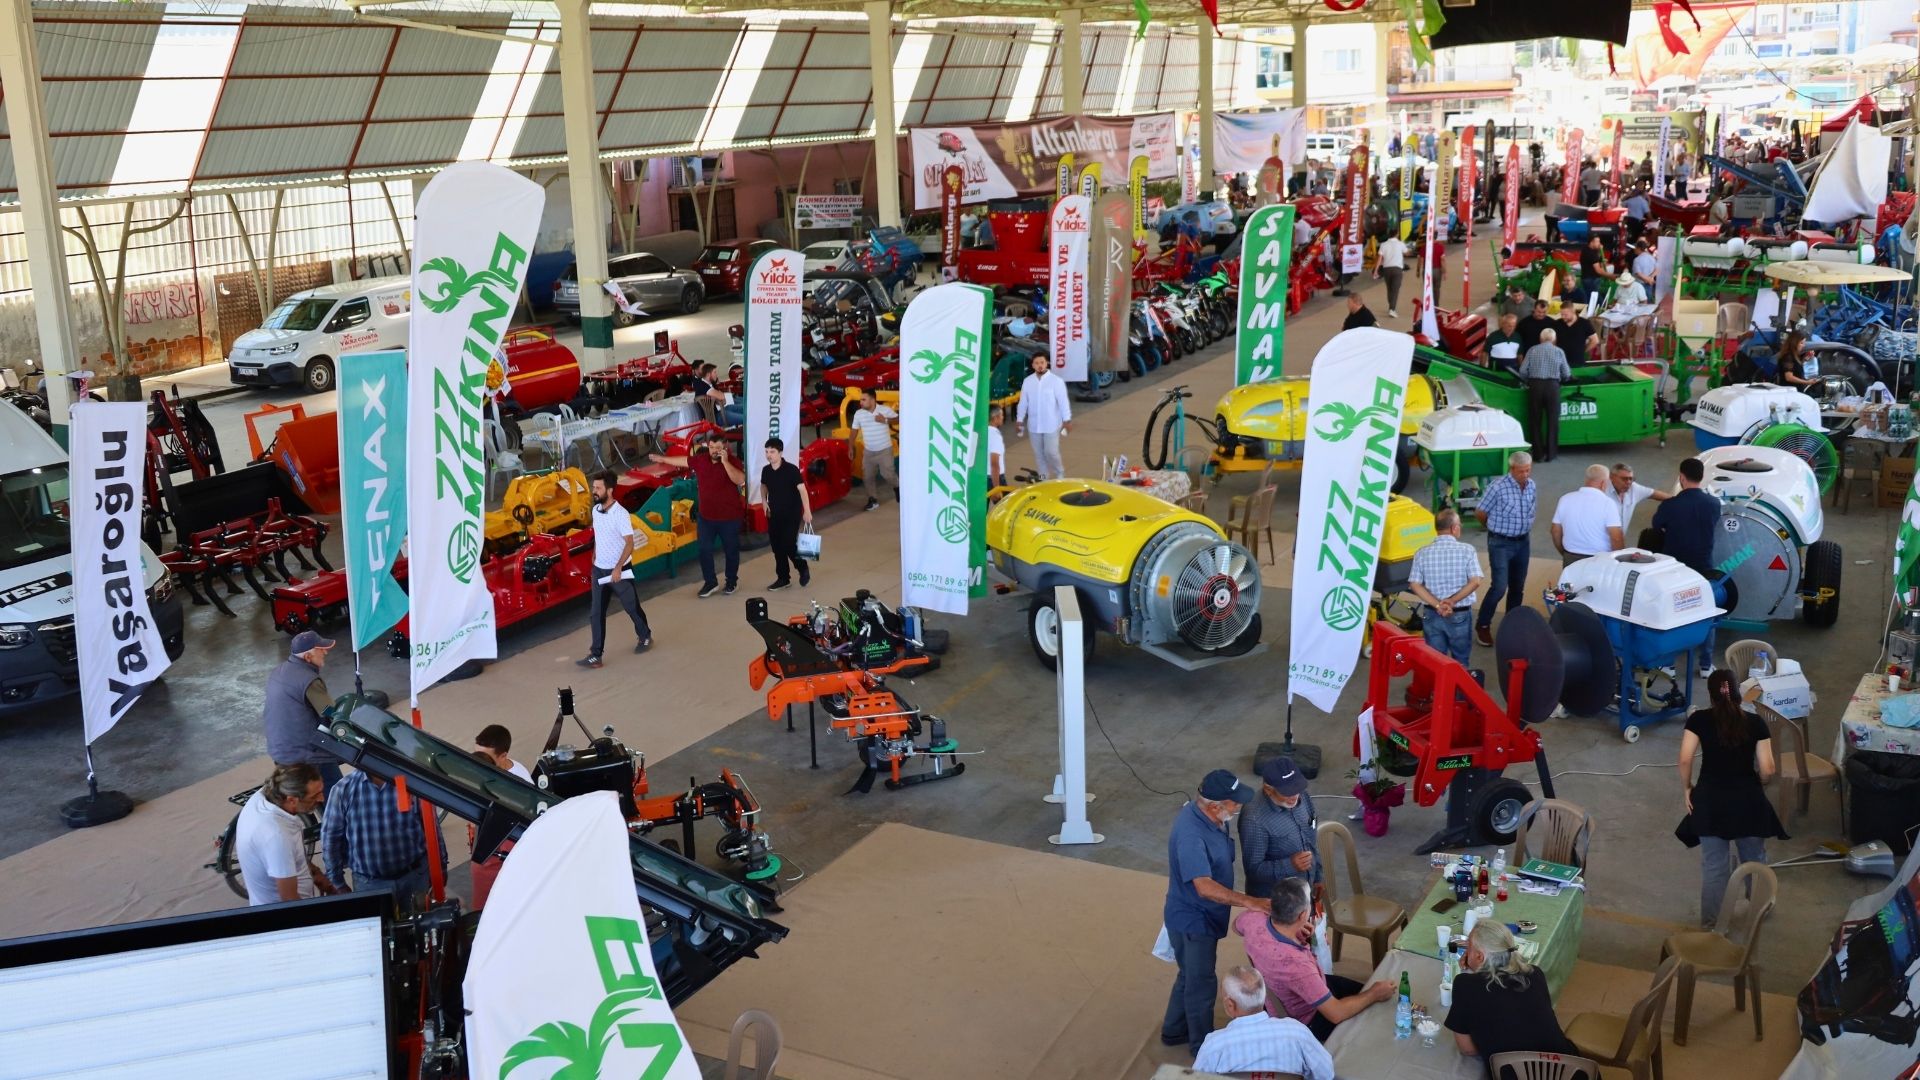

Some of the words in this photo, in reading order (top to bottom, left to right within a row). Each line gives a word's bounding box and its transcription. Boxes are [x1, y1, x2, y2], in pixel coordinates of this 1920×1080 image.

[1058, 244, 1068, 265] VE
[113, 283, 205, 325] AYRA
[1069, 272, 1083, 341] TİCARET
[770, 311, 782, 367] TARIM
[769, 371, 781, 440] RDUSAR
[1699, 400, 1724, 417] SAVMAK
[1024, 508, 1062, 527] SAVMAK
[95, 430, 149, 718] Yaşaroğlu
[908, 572, 927, 582] 0506
[945, 576, 955, 586] 89
[0, 577, 57, 603] TEST
[1302, 664, 1320, 675] 171
[1322, 669, 1335, 679] 89
[1773, 696, 1798, 706] kardan
